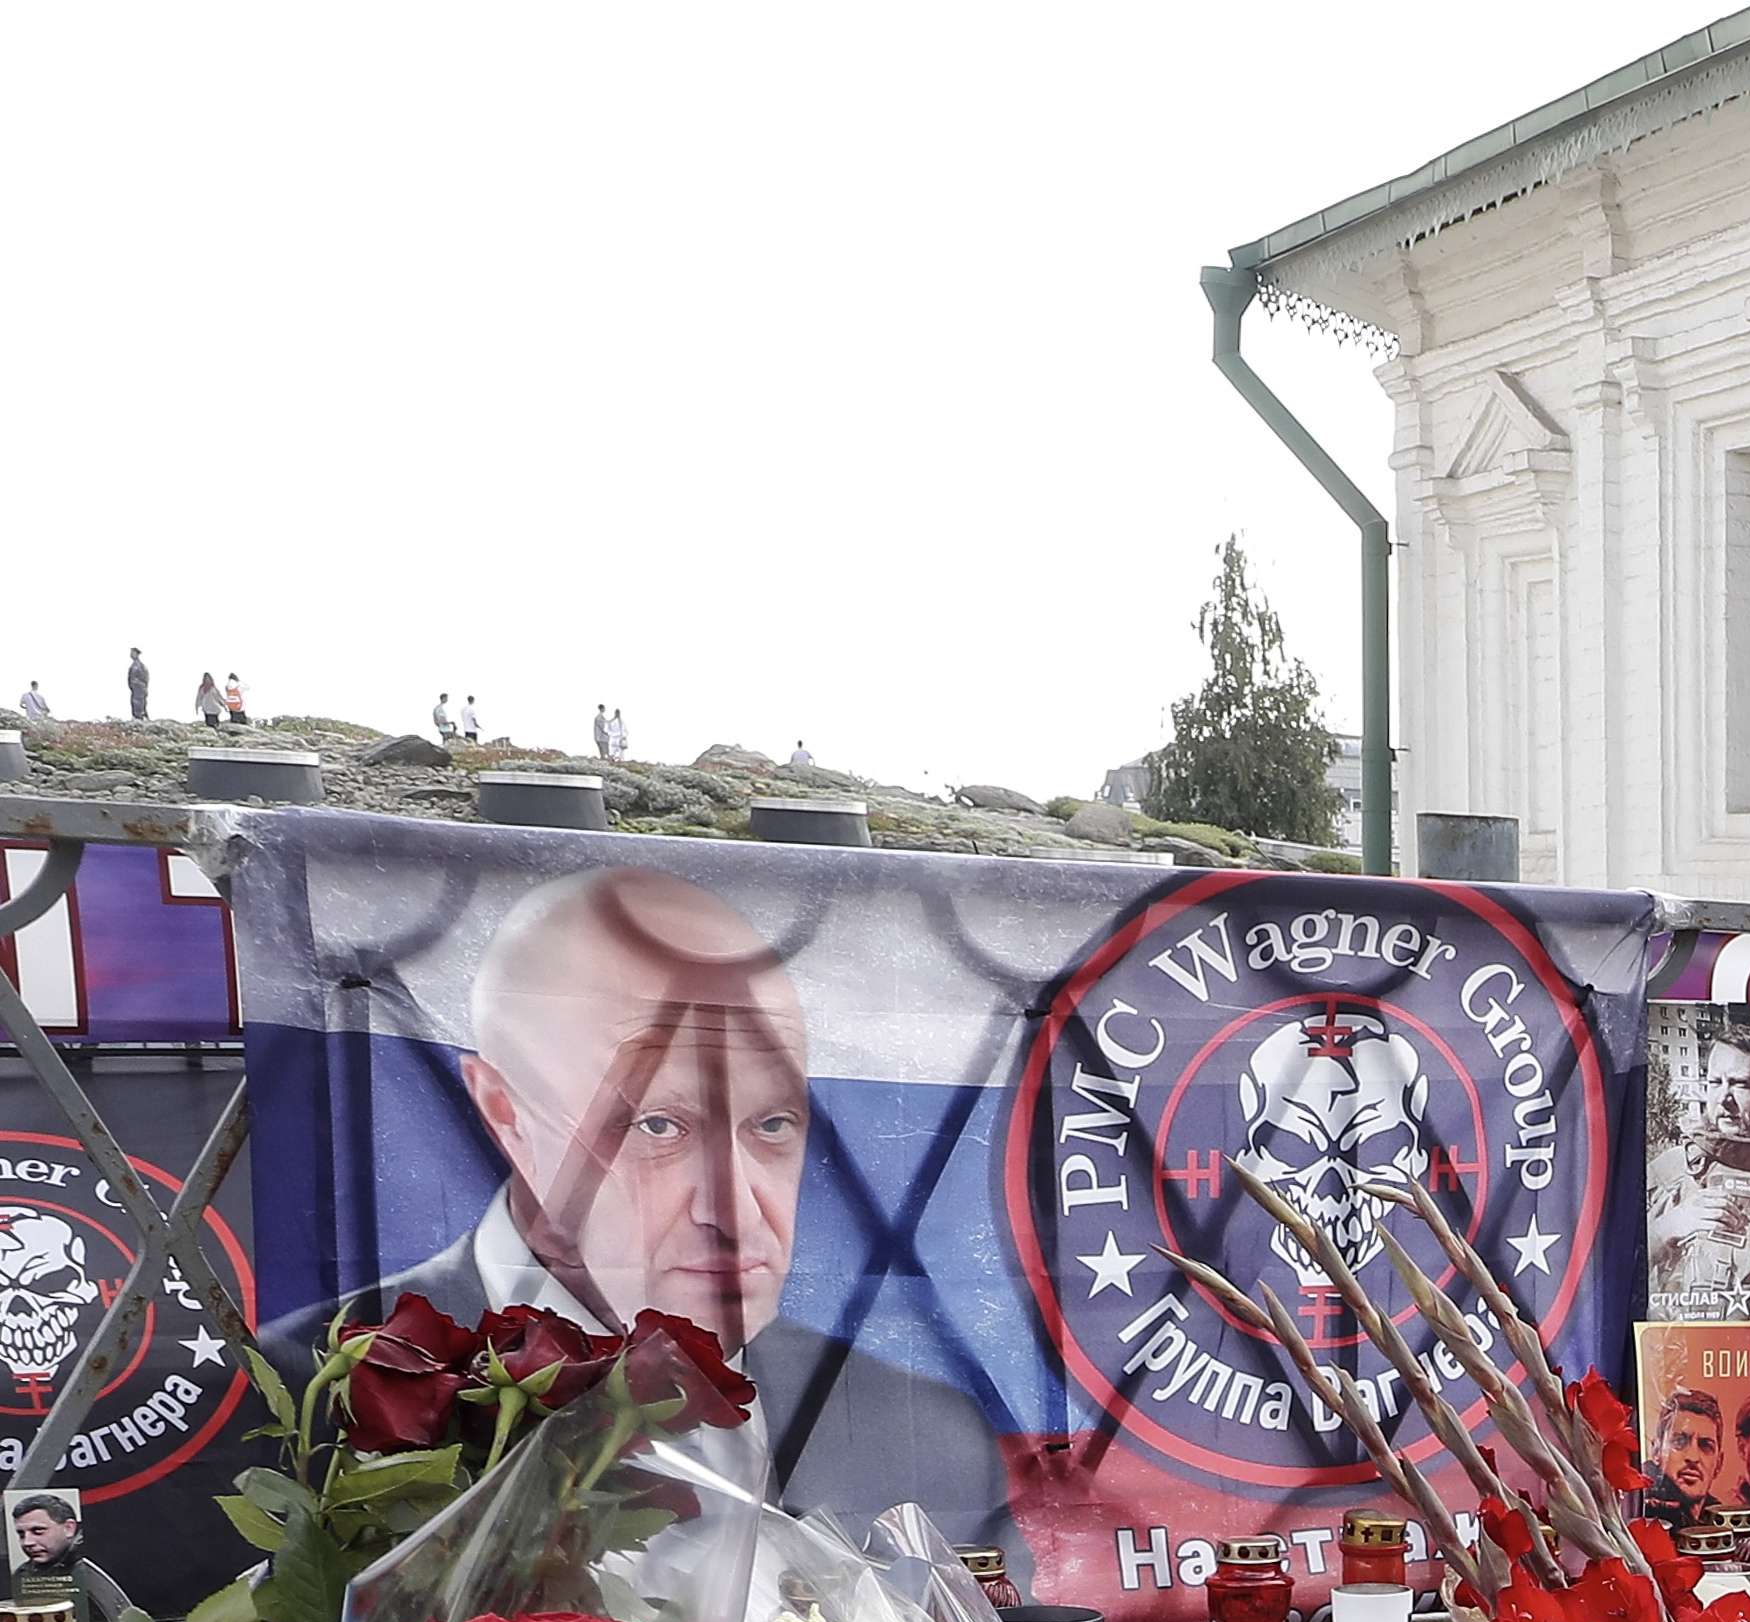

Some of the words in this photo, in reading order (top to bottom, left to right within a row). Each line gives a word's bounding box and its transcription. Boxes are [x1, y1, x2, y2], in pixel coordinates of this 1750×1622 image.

[1059, 998, 1166, 1217] PMC
[1149, 908, 1457, 1002] Wagner
[1460, 963, 1558, 1190] Group
[1650, 1292, 1719, 1307] СТИСЛАВ
[1117, 1292, 1292, 1431] Группа
[55, 1373, 204, 1473] агнера
